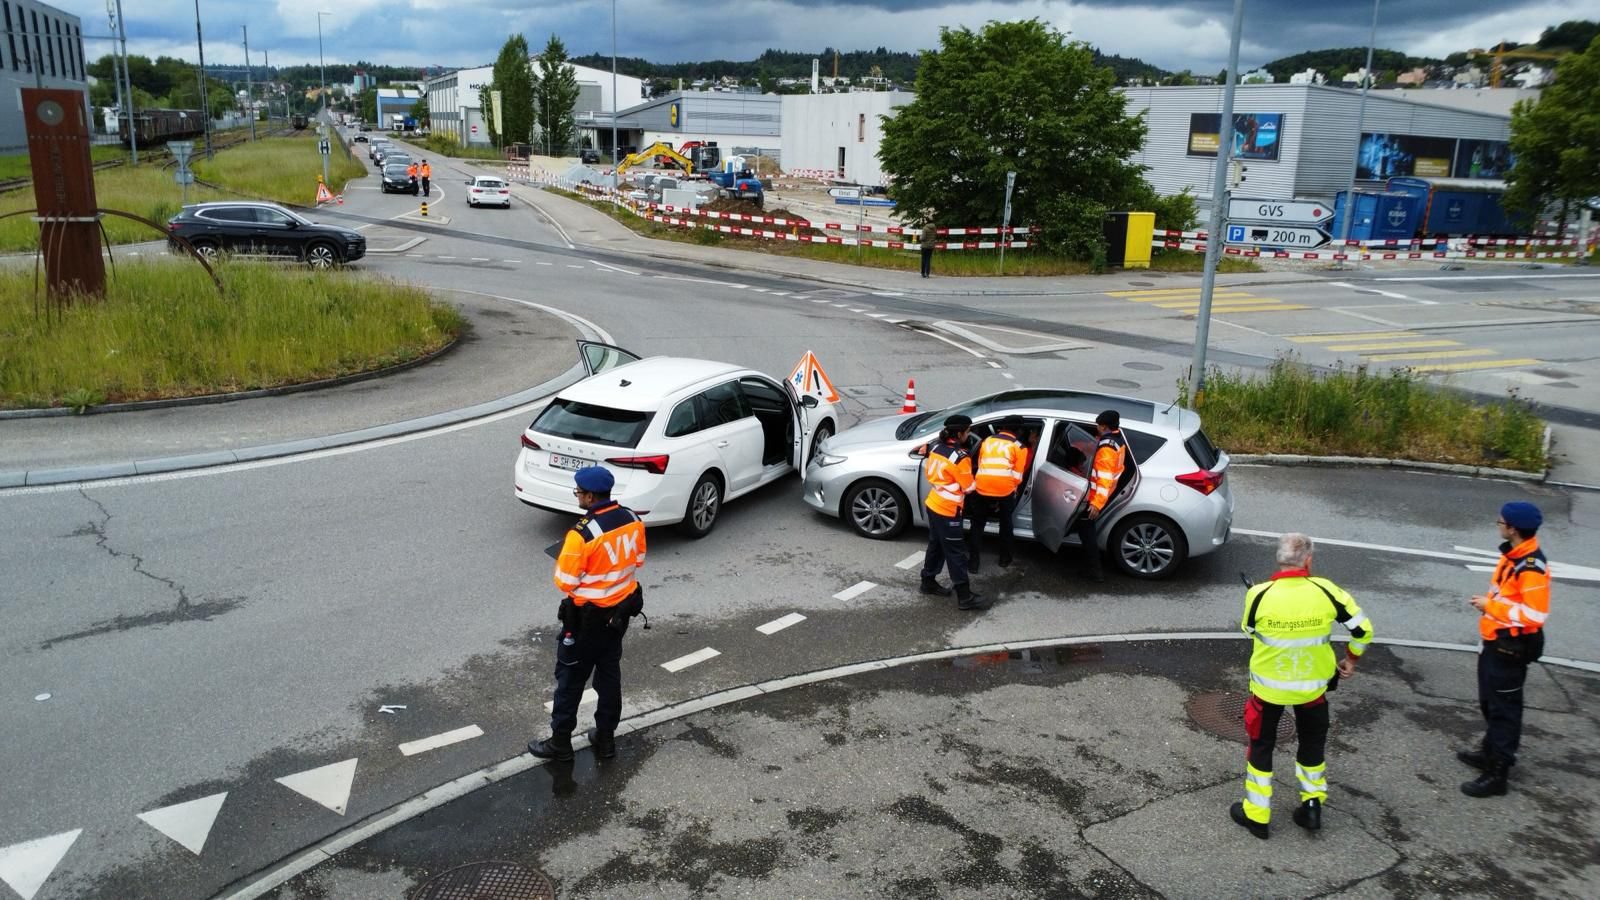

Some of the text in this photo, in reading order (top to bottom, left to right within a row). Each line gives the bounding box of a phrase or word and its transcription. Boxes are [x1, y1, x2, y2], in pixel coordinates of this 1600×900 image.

[1258, 204, 1284, 217] GVS
[1233, 229, 1311, 244] P 200 m
[986, 439, 1012, 459] VK
[560, 456, 569, 466] SH
[603, 529, 639, 566] VK
[1267, 617, 1324, 631] Rettungssanitäter
